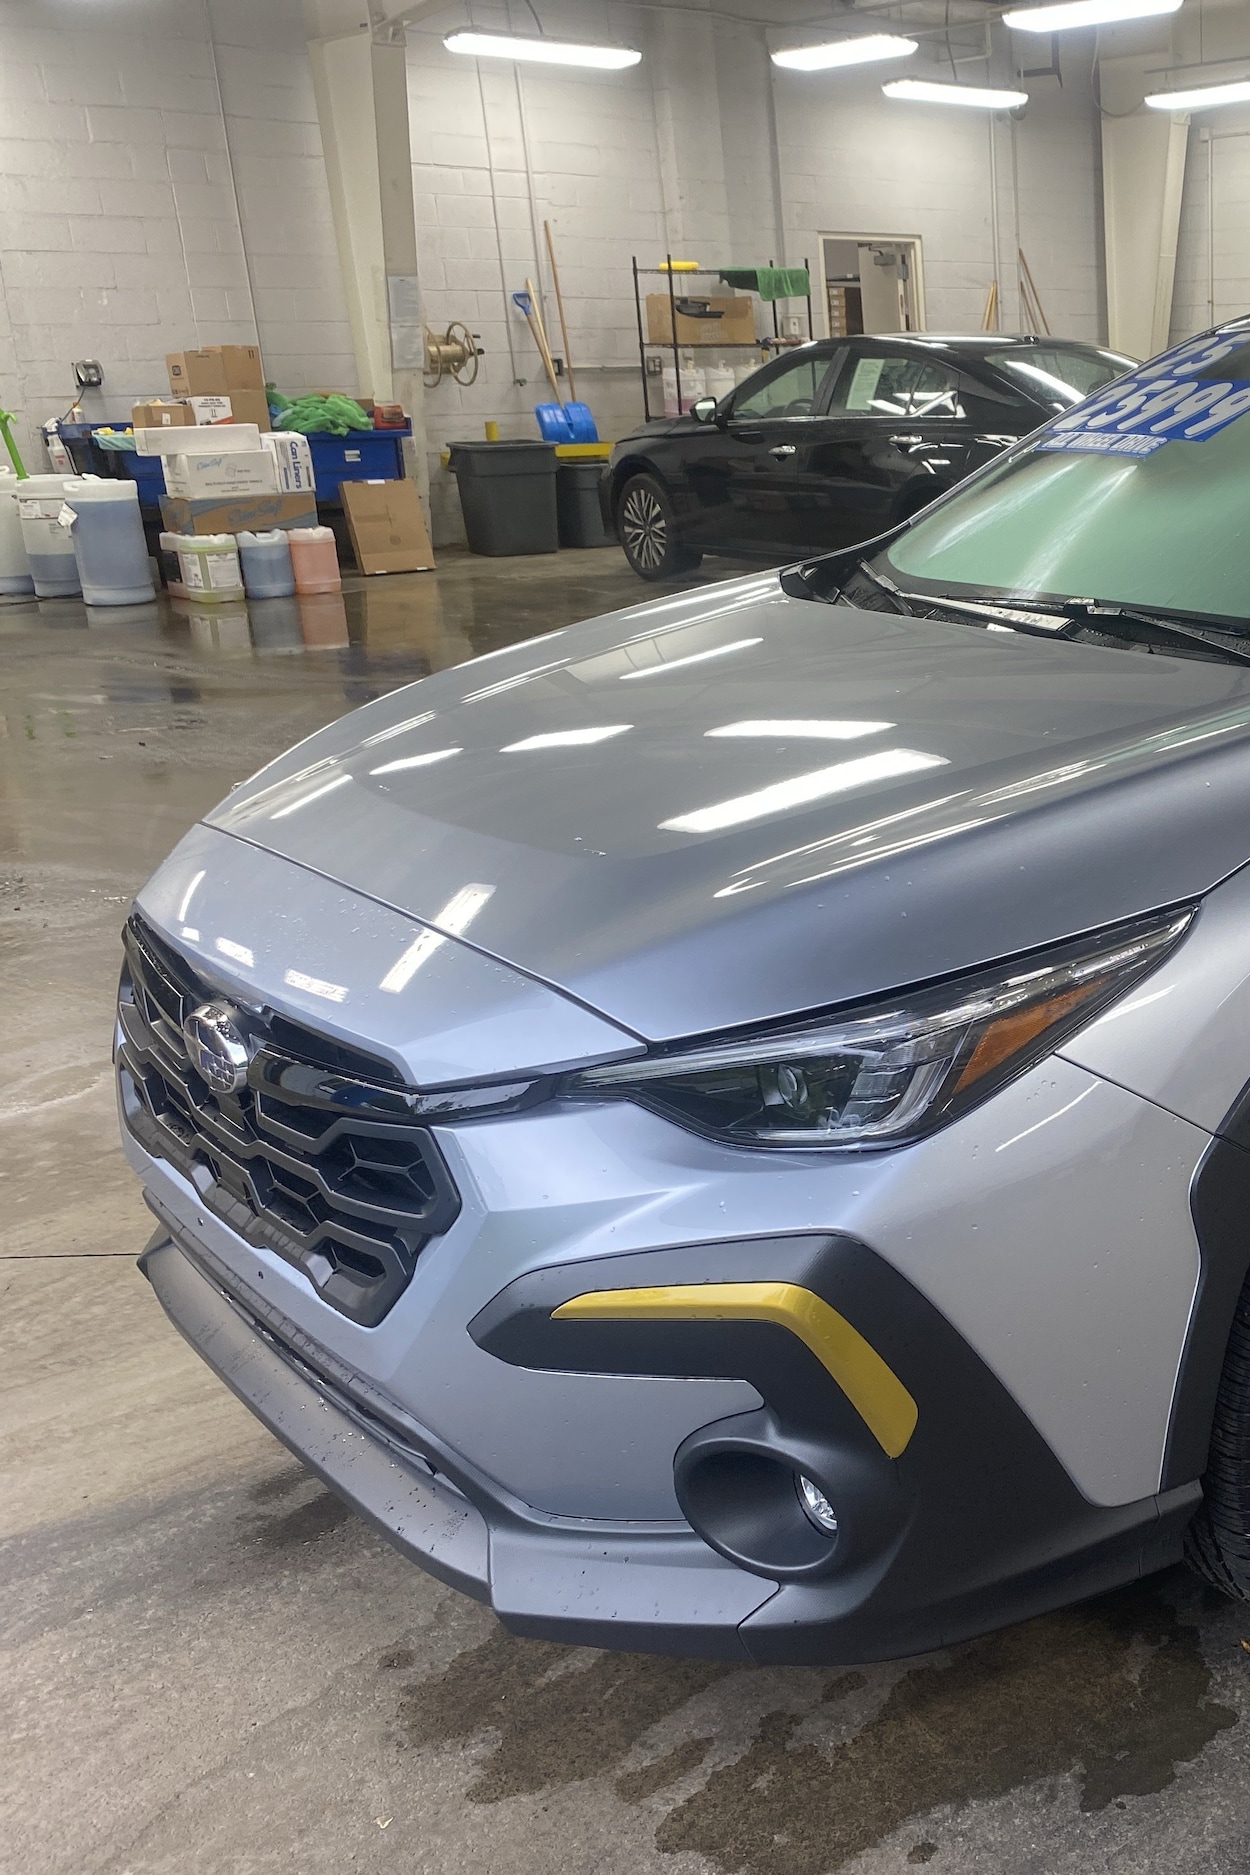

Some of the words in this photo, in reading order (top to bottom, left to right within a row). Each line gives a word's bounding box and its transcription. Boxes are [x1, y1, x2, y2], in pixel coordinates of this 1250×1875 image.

[287, 441, 300, 460] Can
[1109, 435, 1168, 455] DRIVE
[292, 461, 303, 490] Liners
